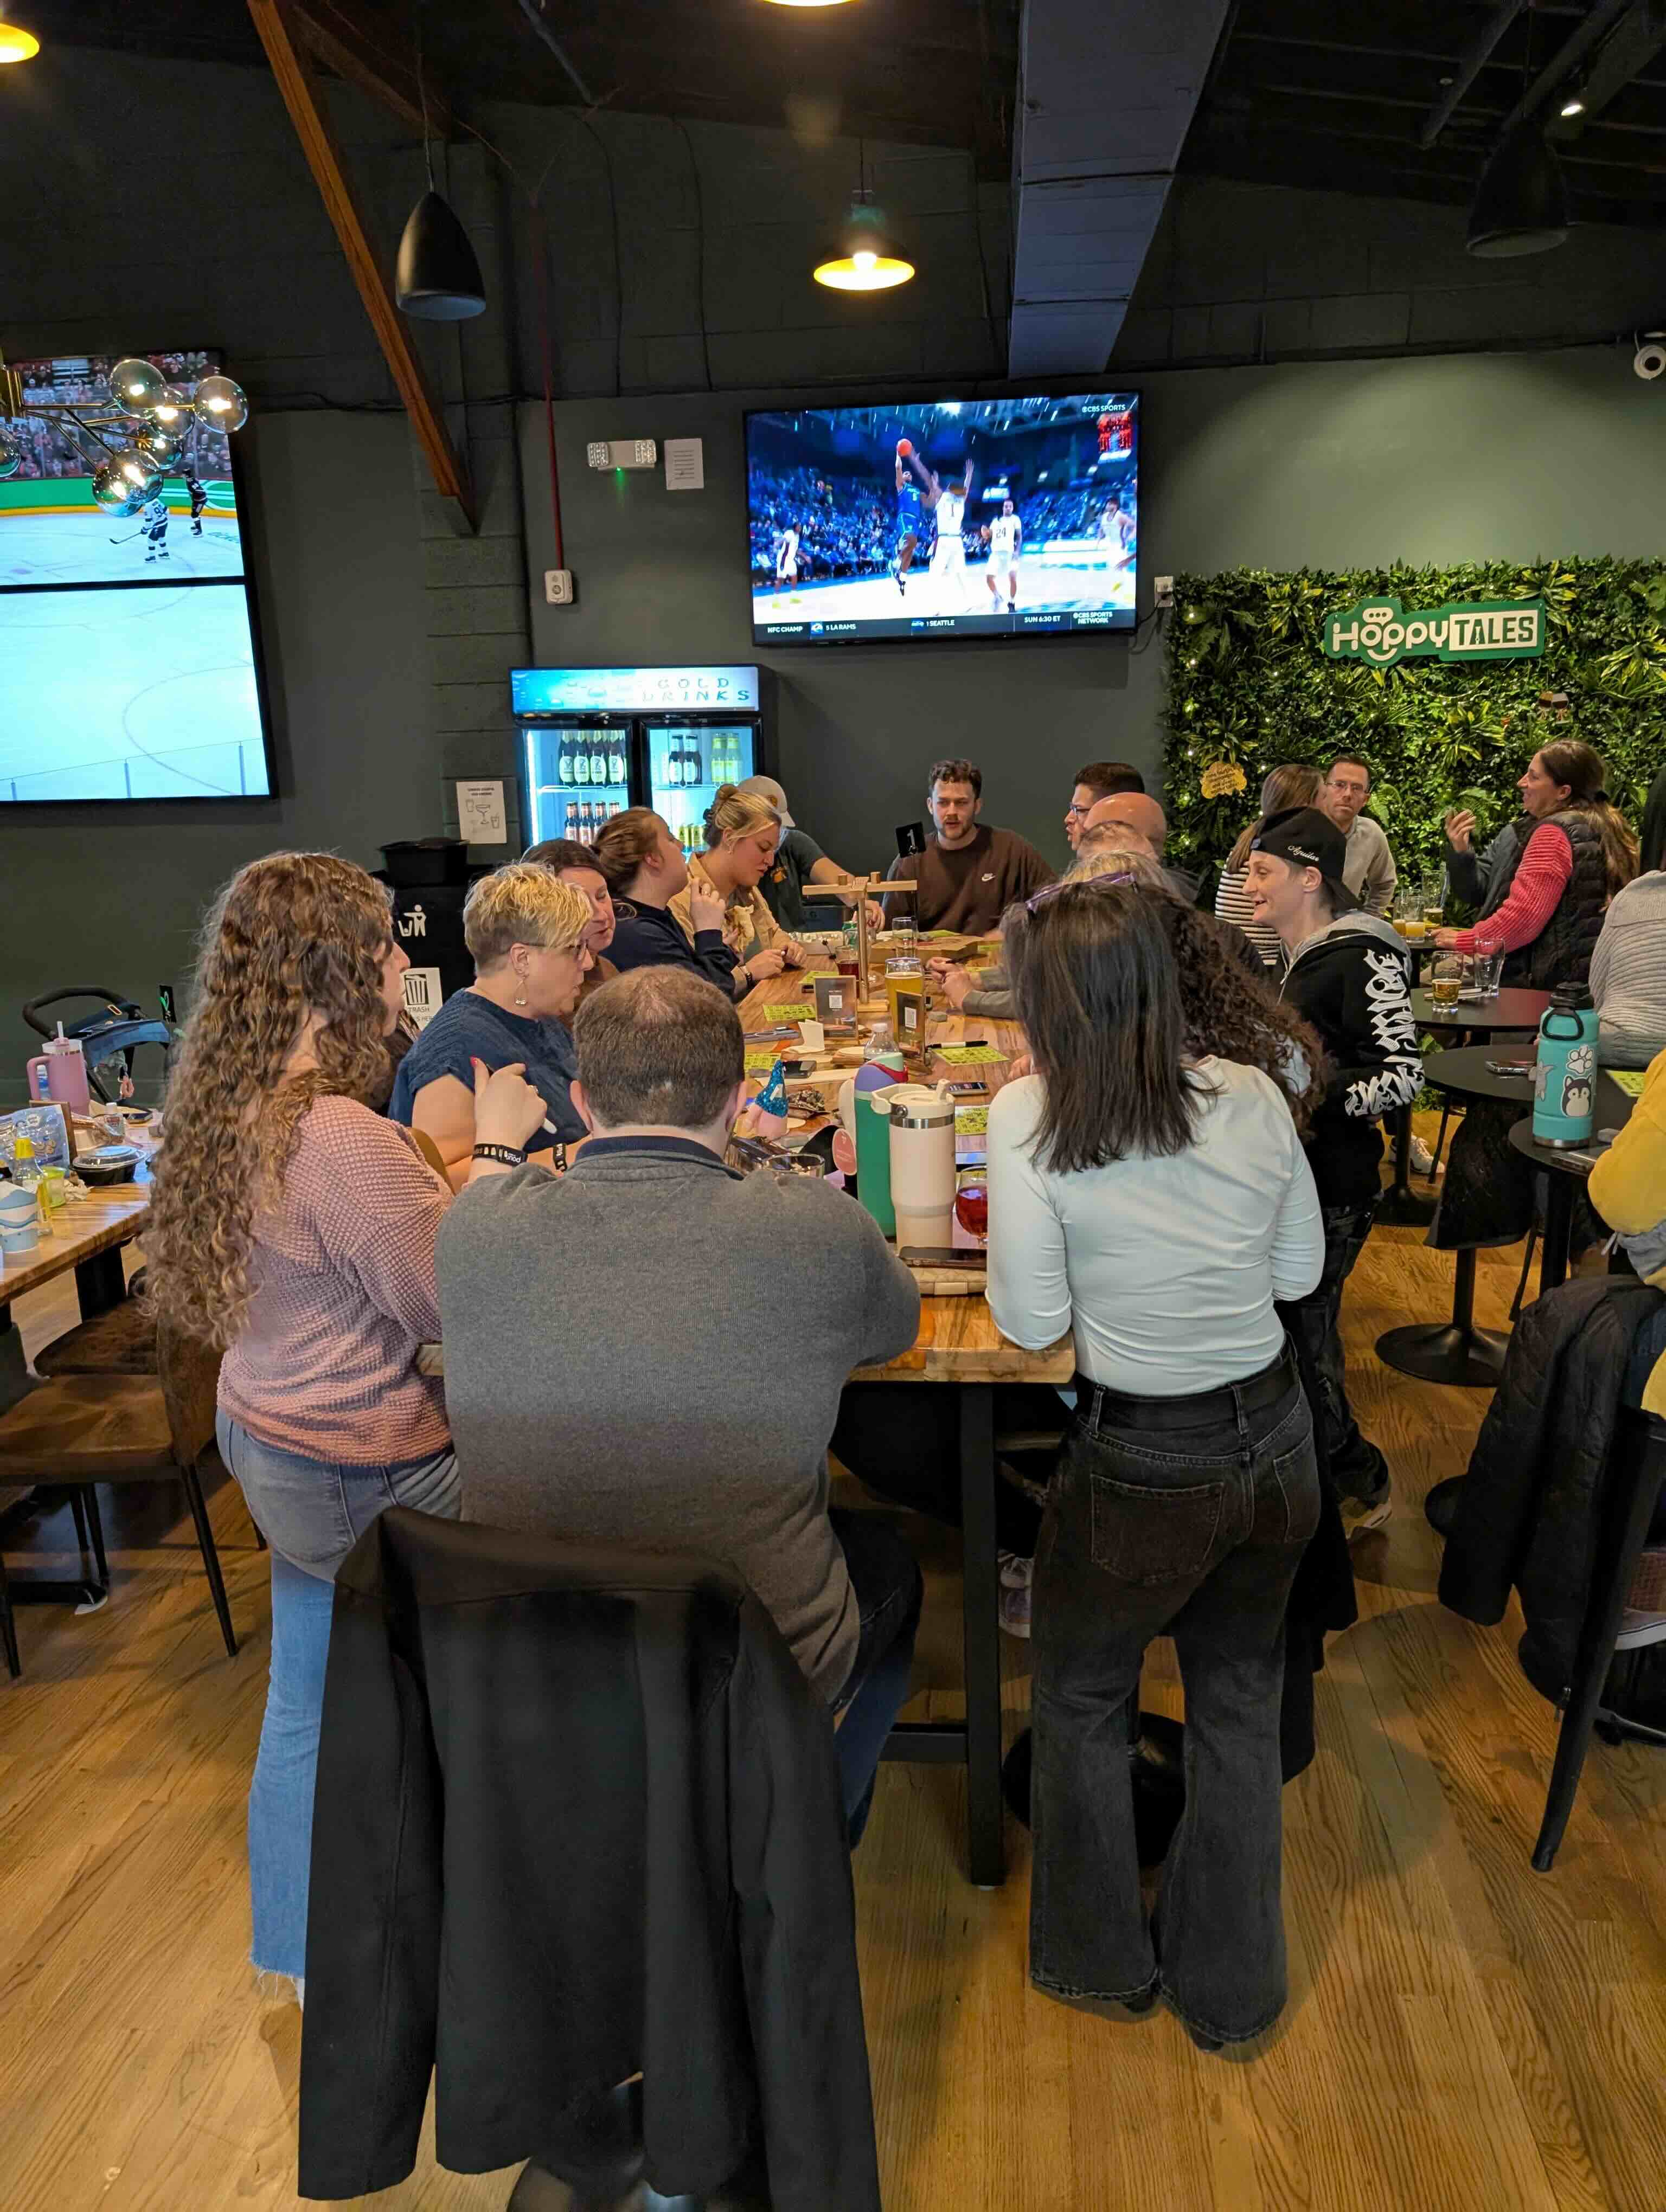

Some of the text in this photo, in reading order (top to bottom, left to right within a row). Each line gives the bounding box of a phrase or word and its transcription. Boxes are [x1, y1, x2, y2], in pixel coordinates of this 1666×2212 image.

[996, 527, 1006, 538] 24
[657, 678, 729, 689] COLD
[642, 690, 750, 702] DRINKS
